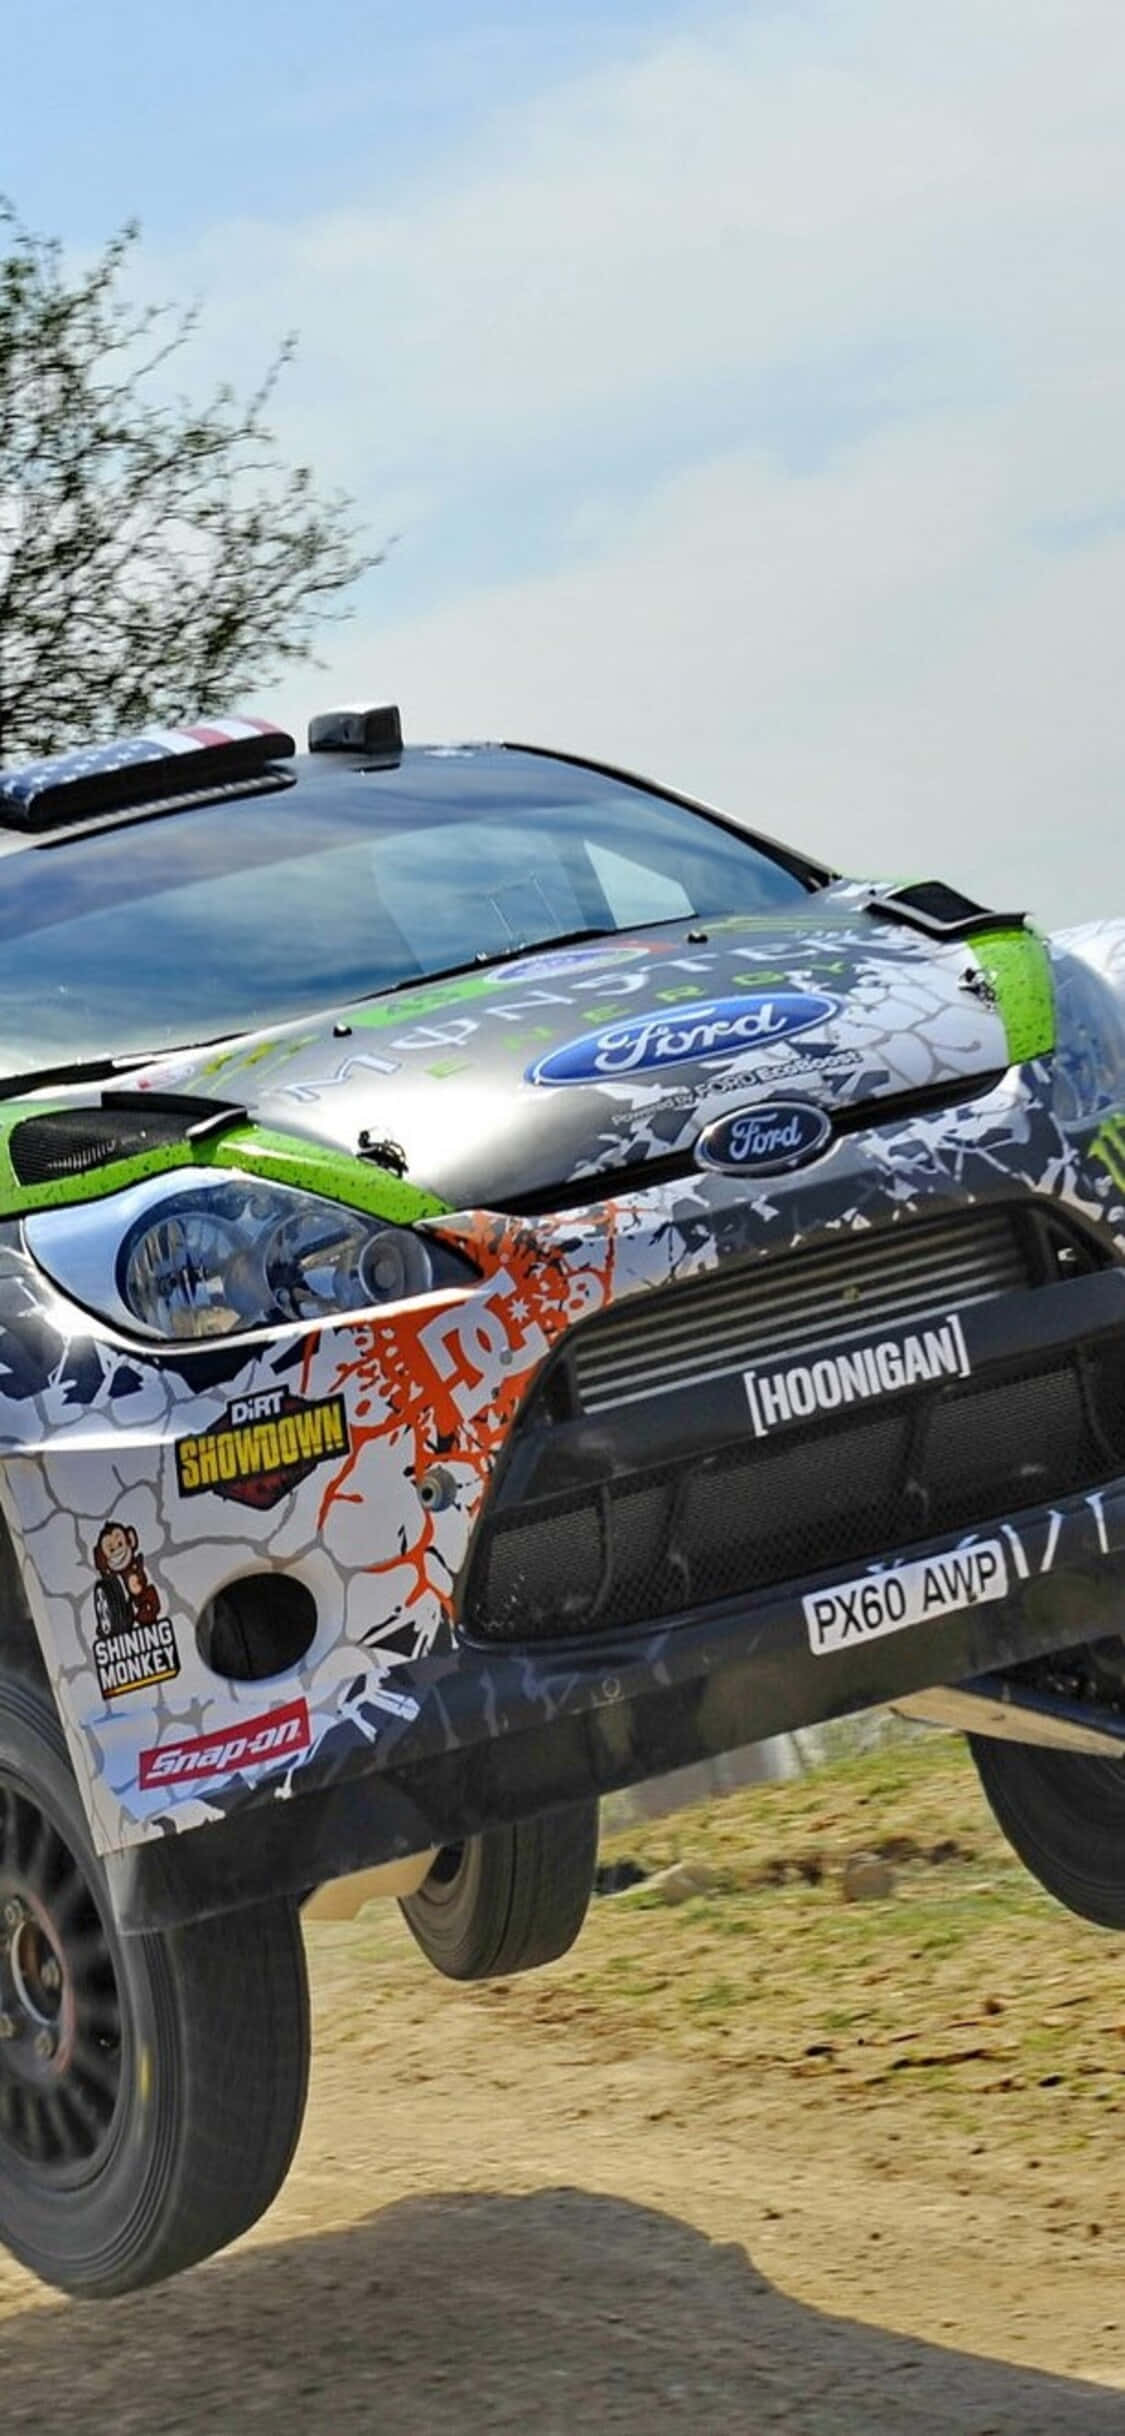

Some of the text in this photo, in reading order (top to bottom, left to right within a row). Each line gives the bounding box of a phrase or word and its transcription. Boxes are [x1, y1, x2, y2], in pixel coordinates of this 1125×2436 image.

[595, 1002, 787, 1082] Ford
[697, 1068, 758, 1098] FORD
[760, 1048, 864, 1084] EcoBoost
[729, 1111, 802, 1161] Ford
[179, 1403, 345, 1489] SHOWDOWN
[813, 1550, 998, 1645] PX60 AWP
[95, 1621, 173, 1665] SHINING
[100, 1645, 177, 1690] MONKEY
[146, 1718, 301, 1780] Snap-on
